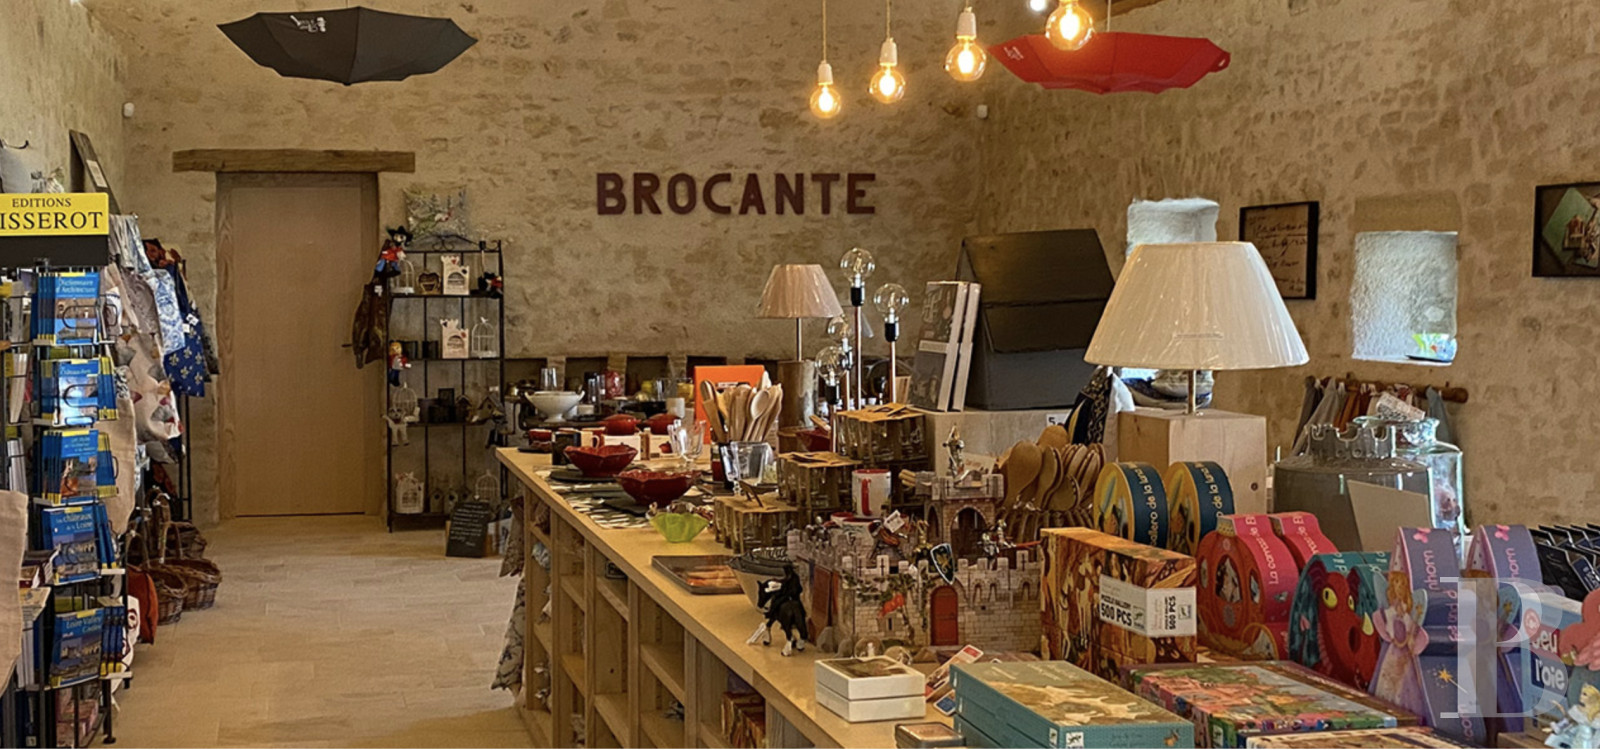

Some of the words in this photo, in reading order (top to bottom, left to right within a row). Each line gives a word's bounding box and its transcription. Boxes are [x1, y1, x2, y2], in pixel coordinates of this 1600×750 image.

[597, 172, 876, 215] BROCANTE
[12, 198, 71, 208] EDITIONS
[1146, 495, 1157, 510] de
[1211, 495, 1223, 510] de
[1267, 570, 1280, 585] La
[1423, 550, 1443, 591] nhorn
[1168, 595, 1177, 613] PCS
[1101, 603, 1115, 620] 500
[1116, 608, 1133, 627] PCS
[1534, 658, 1566, 690] l'oie
